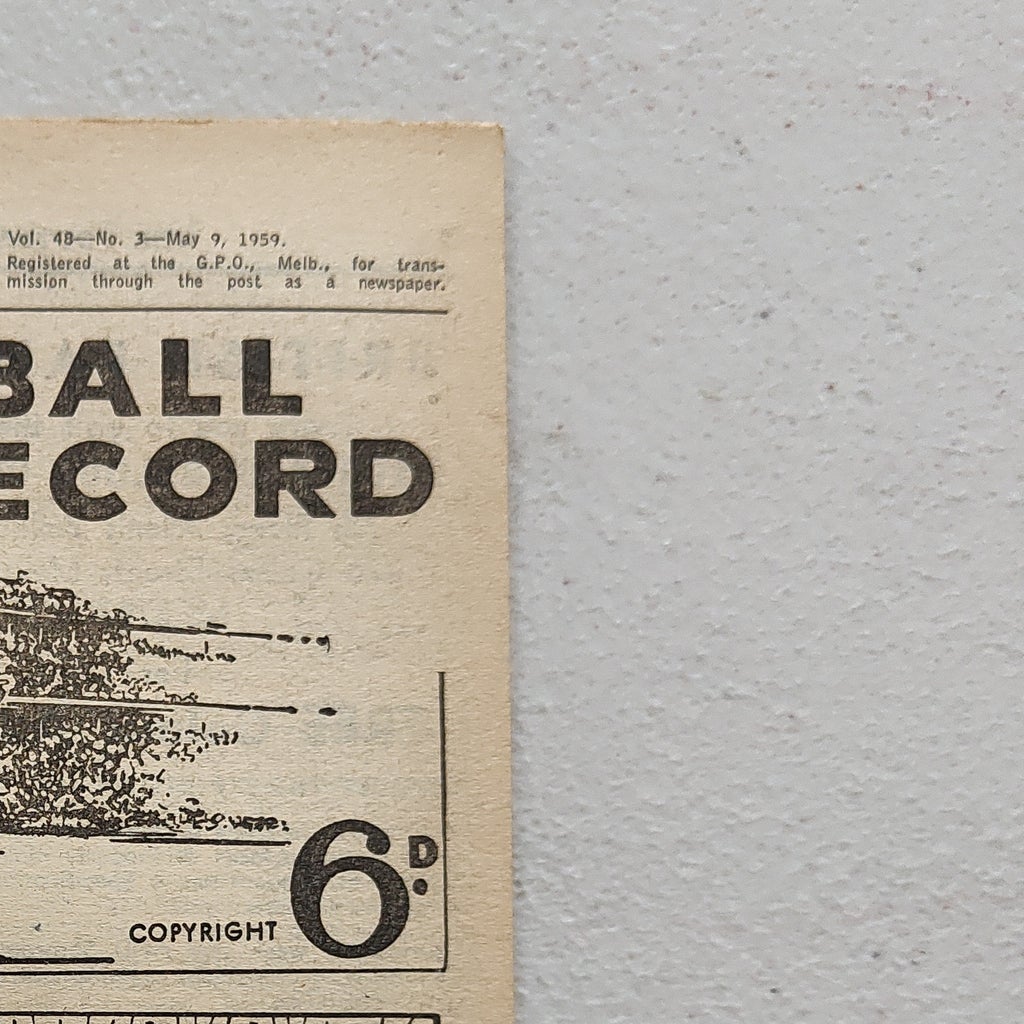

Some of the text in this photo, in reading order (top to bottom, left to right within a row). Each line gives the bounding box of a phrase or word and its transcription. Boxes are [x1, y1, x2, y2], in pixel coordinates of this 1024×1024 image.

[7, 230, 40, 247] Vol.
[210, 233, 226, 249] 9,
[239, 233, 287, 248] 1959.
[7, 255, 92, 273] Registered
[113, 257, 130, 270] at
[151, 256, 176, 270] the
[196, 255, 256, 273] G.P.O.,
[352, 257, 376, 271] for
[398, 258, 446, 272] trans-
[7, 273, 447, 293] mission through the post as a newspaper.
[290, 818, 411, 959] 6
[128, 921, 278, 944] COPYRIGHT
